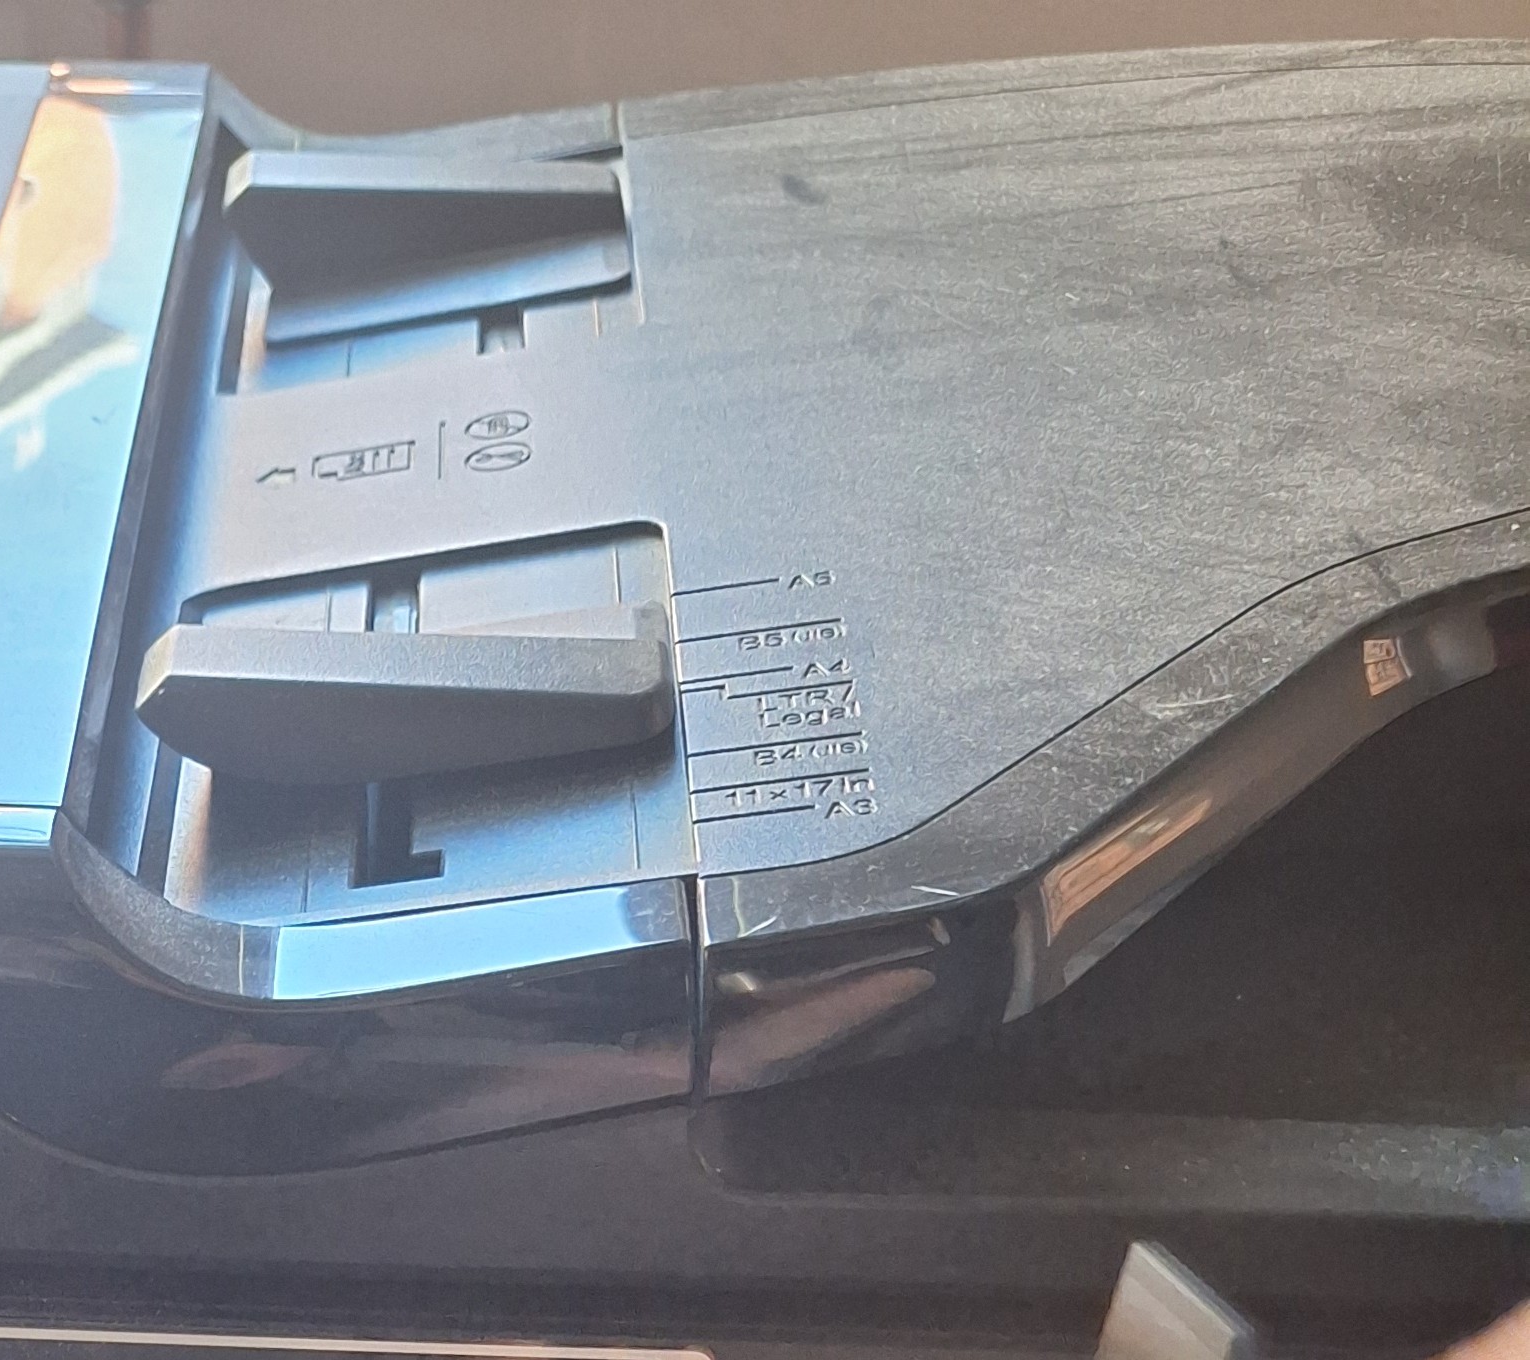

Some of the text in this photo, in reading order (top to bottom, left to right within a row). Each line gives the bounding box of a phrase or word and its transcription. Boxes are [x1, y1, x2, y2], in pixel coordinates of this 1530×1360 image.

[787, 569, 837, 590] A5
[737, 631, 787, 651] B5
[802, 657, 851, 679] A4
[758, 700, 862, 730] Legal
[753, 745, 804, 766] B4
[724, 788, 762, 807] 11
[792, 778, 834, 798] 17
[823, 798, 877, 819] A3
